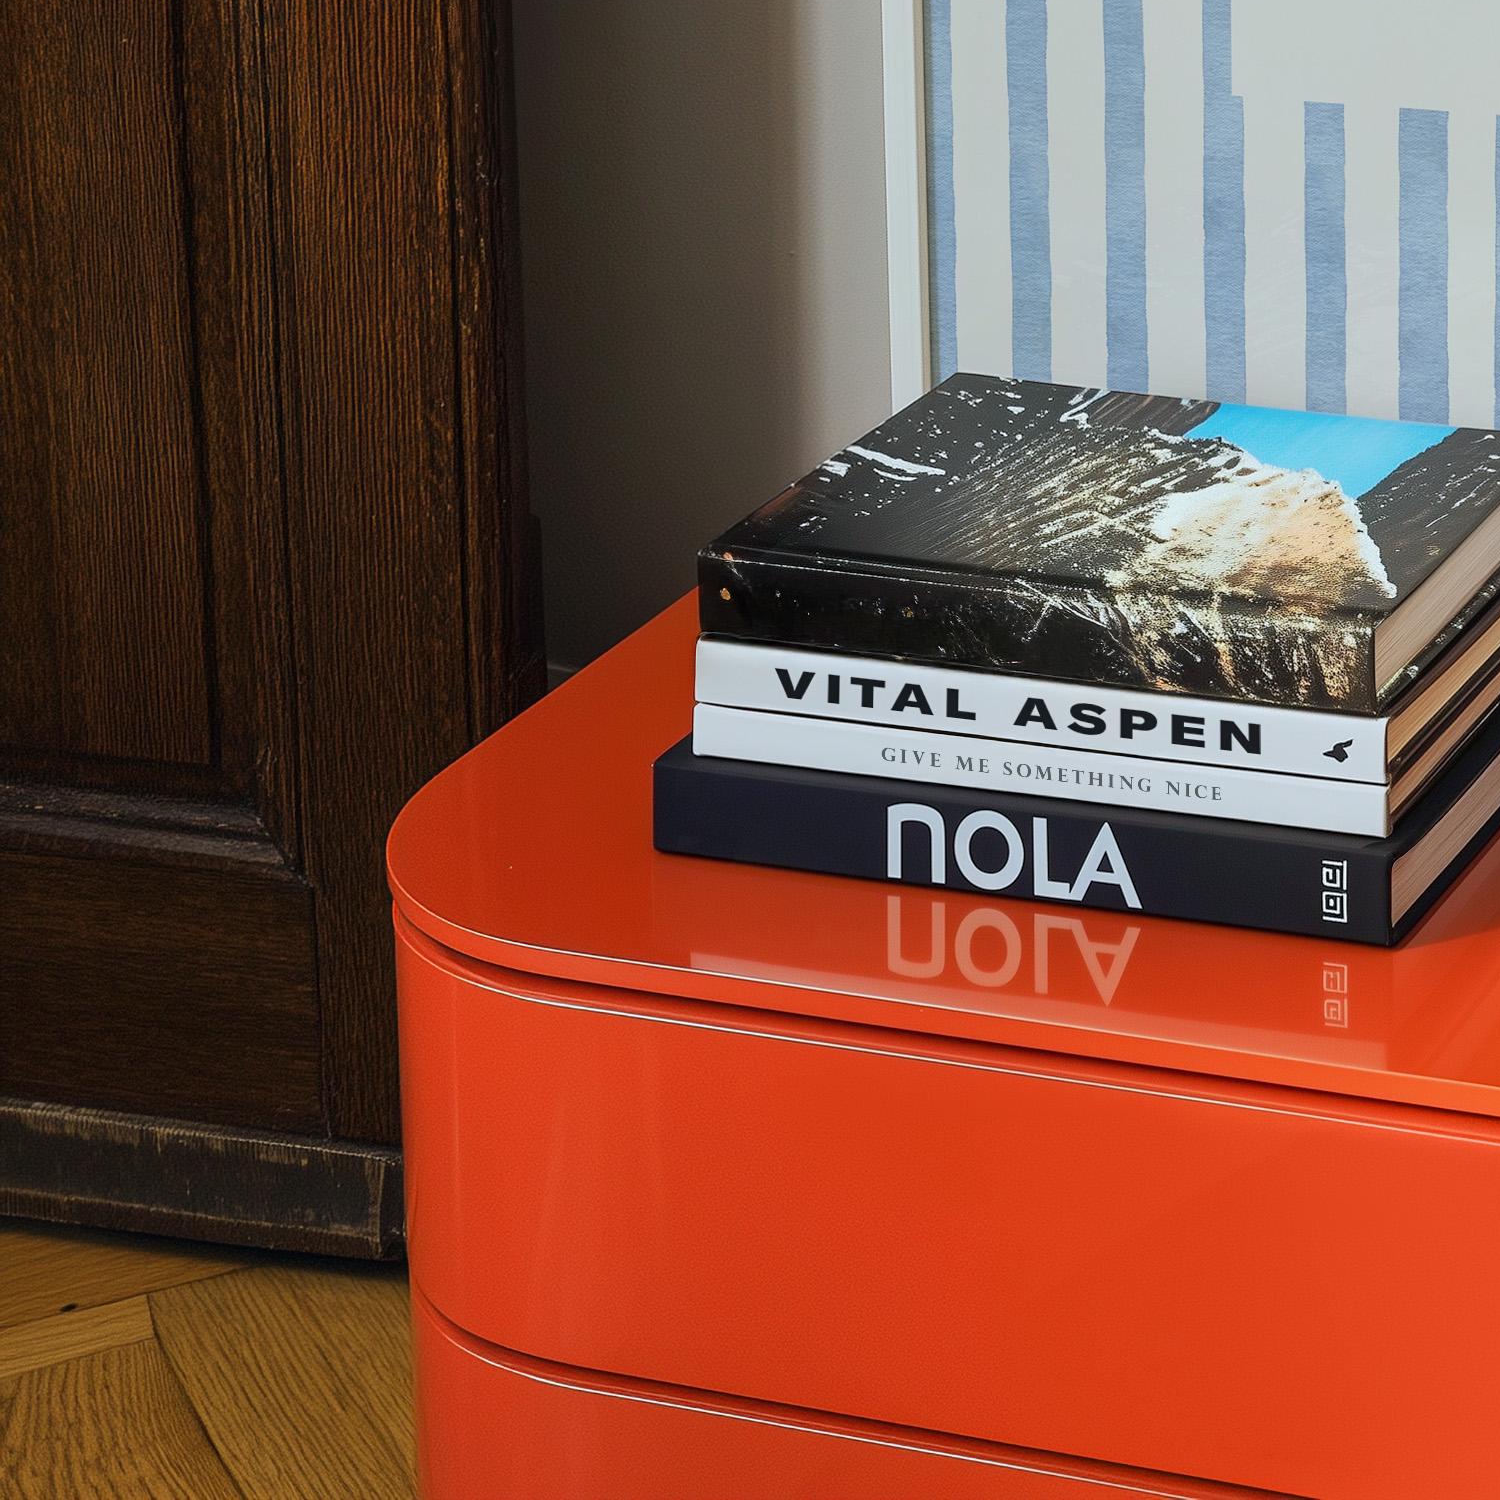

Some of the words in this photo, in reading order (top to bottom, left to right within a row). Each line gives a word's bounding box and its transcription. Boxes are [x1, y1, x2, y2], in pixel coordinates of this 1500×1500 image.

[774, 667, 978, 722] VITAL
[1013, 697, 1263, 756] ASPEN
[881, 747, 942, 769] GIVE
[955, 755, 991, 774] ME
[1002, 761, 1152, 794] SOMETHING
[1165, 780, 1223, 802] NICE
[887, 802, 1143, 910] NOLA
